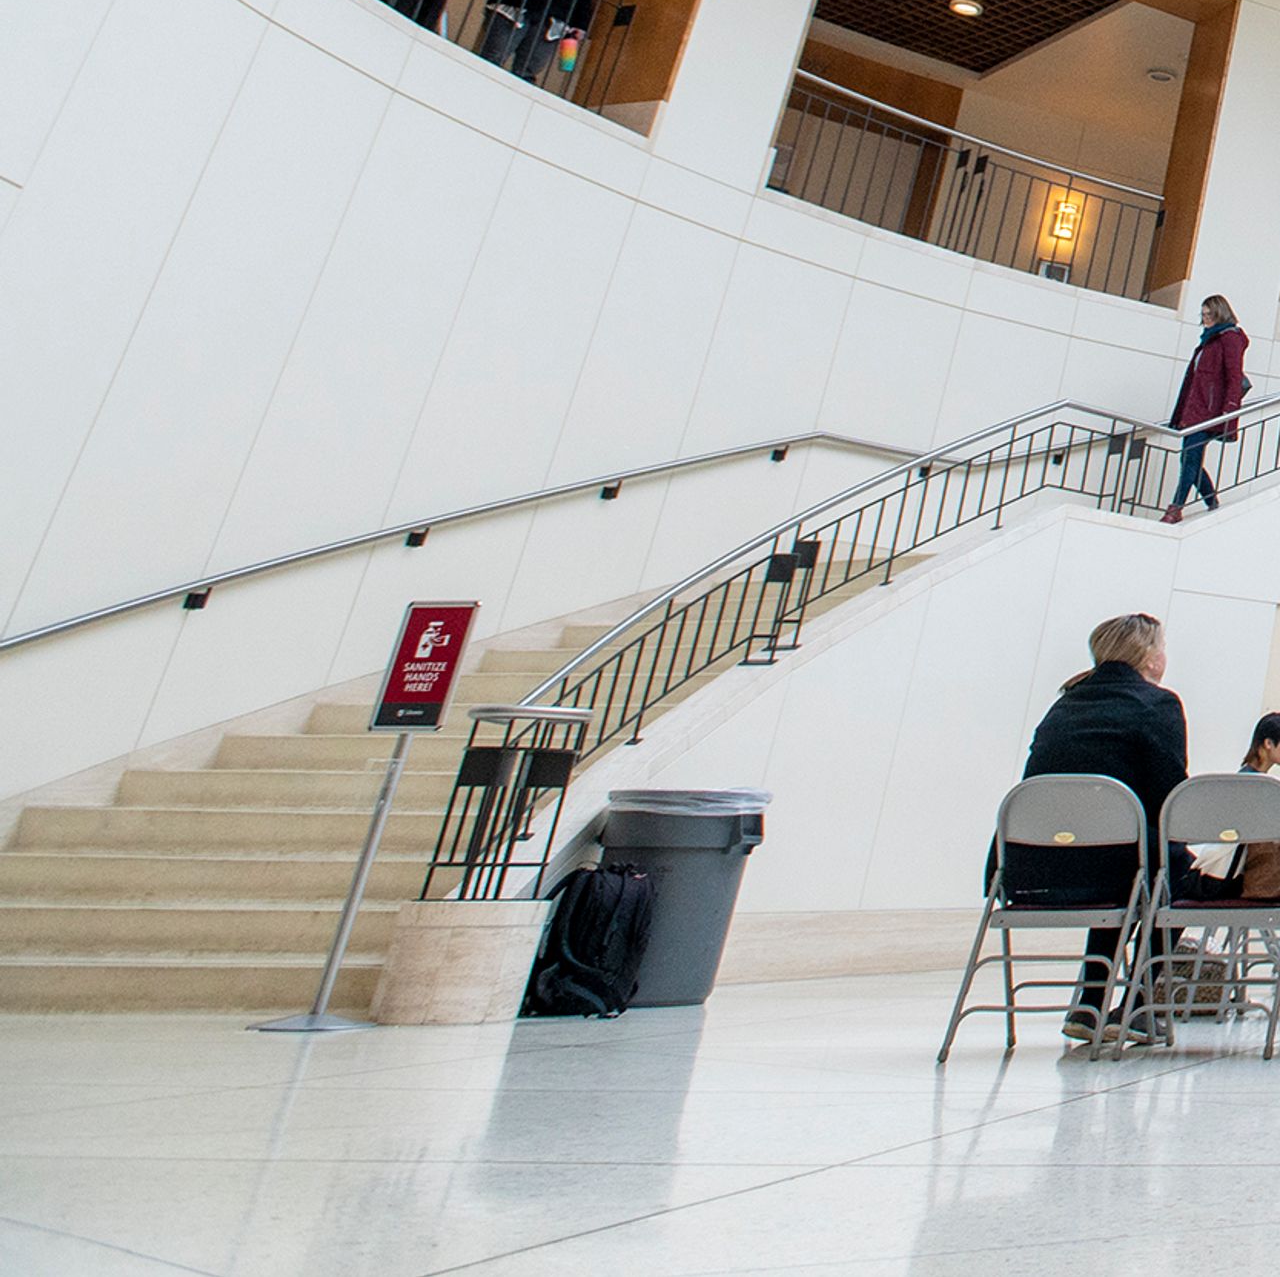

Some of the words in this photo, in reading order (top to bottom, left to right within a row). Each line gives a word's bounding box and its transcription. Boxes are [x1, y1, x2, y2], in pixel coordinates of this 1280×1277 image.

[402, 661, 448, 672] SANITIZE
[403, 672, 440, 682] HANDS
[403, 682, 433, 692] HERE!
